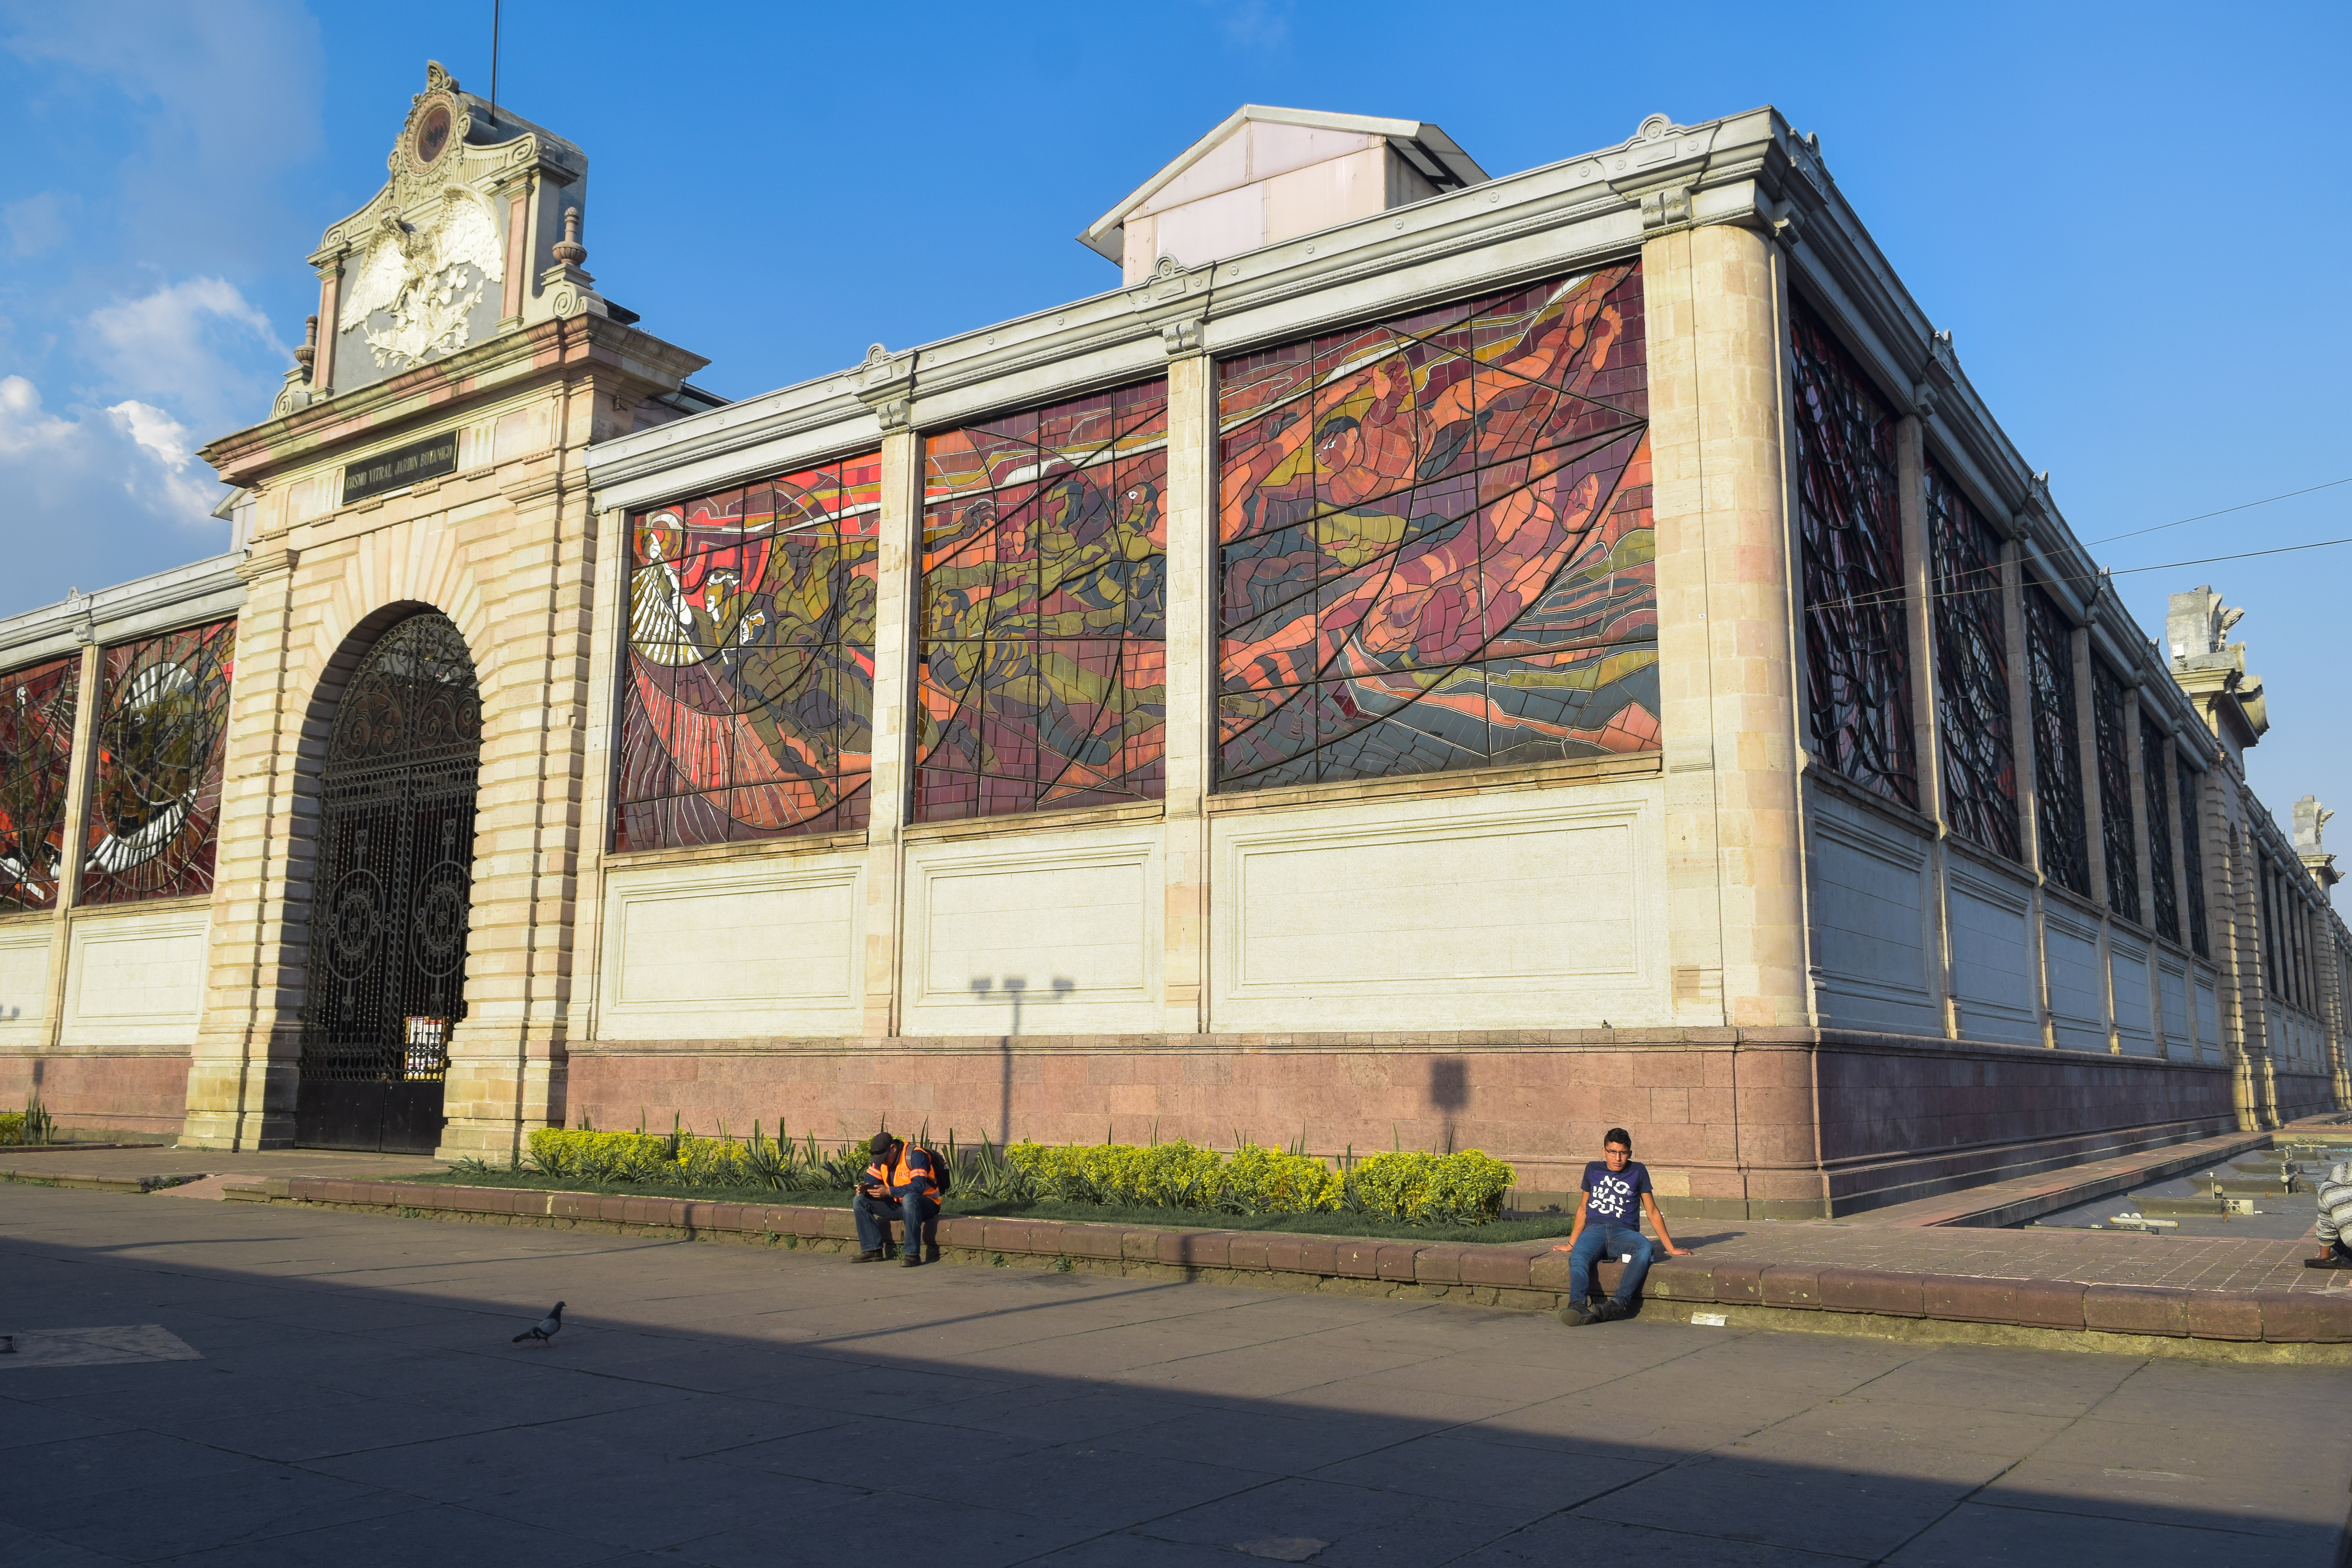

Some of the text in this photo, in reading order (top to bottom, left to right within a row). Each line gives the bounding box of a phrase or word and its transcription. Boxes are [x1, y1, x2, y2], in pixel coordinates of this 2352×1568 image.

[369, 464, 392, 482] VITRAL
[395, 455, 418, 475] JARDIN
[420, 444, 452, 467] BOTANICO
[1600, 1175, 1630, 1194] NO
[1588, 1199, 1626, 1218] OUT
